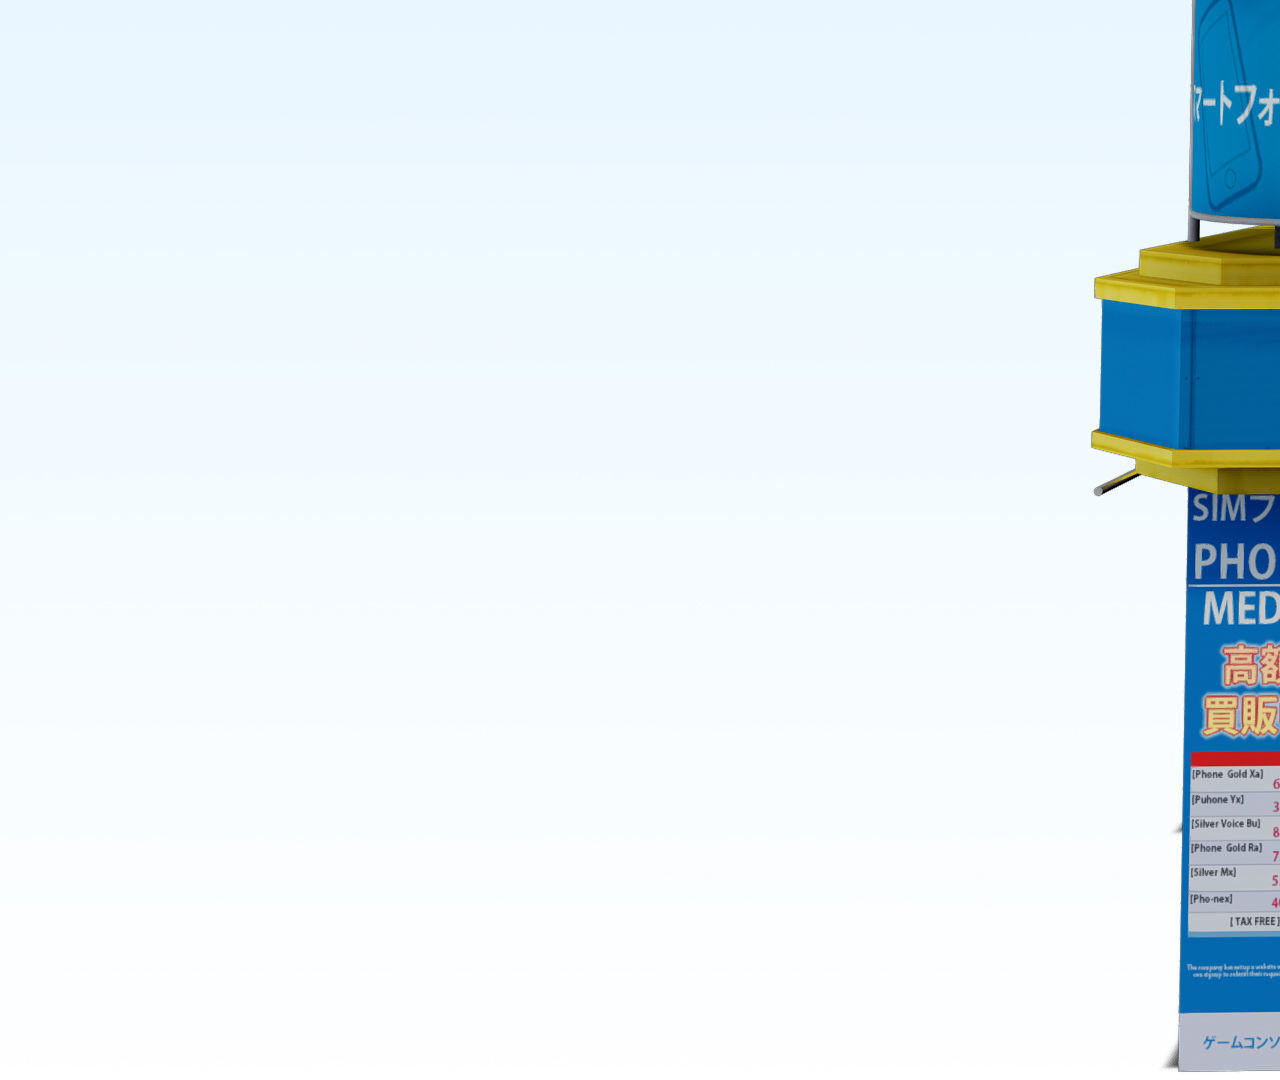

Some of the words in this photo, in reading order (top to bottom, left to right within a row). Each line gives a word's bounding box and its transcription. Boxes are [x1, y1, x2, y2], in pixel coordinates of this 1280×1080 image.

[1192, 770, 1223, 779] [Phone
[1227, 770, 1247, 778] Gold
[1192, 819, 1219, 829] [Silver
[1221, 819, 1244, 828] Voice
[1191, 844, 1222, 853] [Phone
[1226, 843, 1246, 852] Gold
[1191, 868, 1218, 878] [Silver
